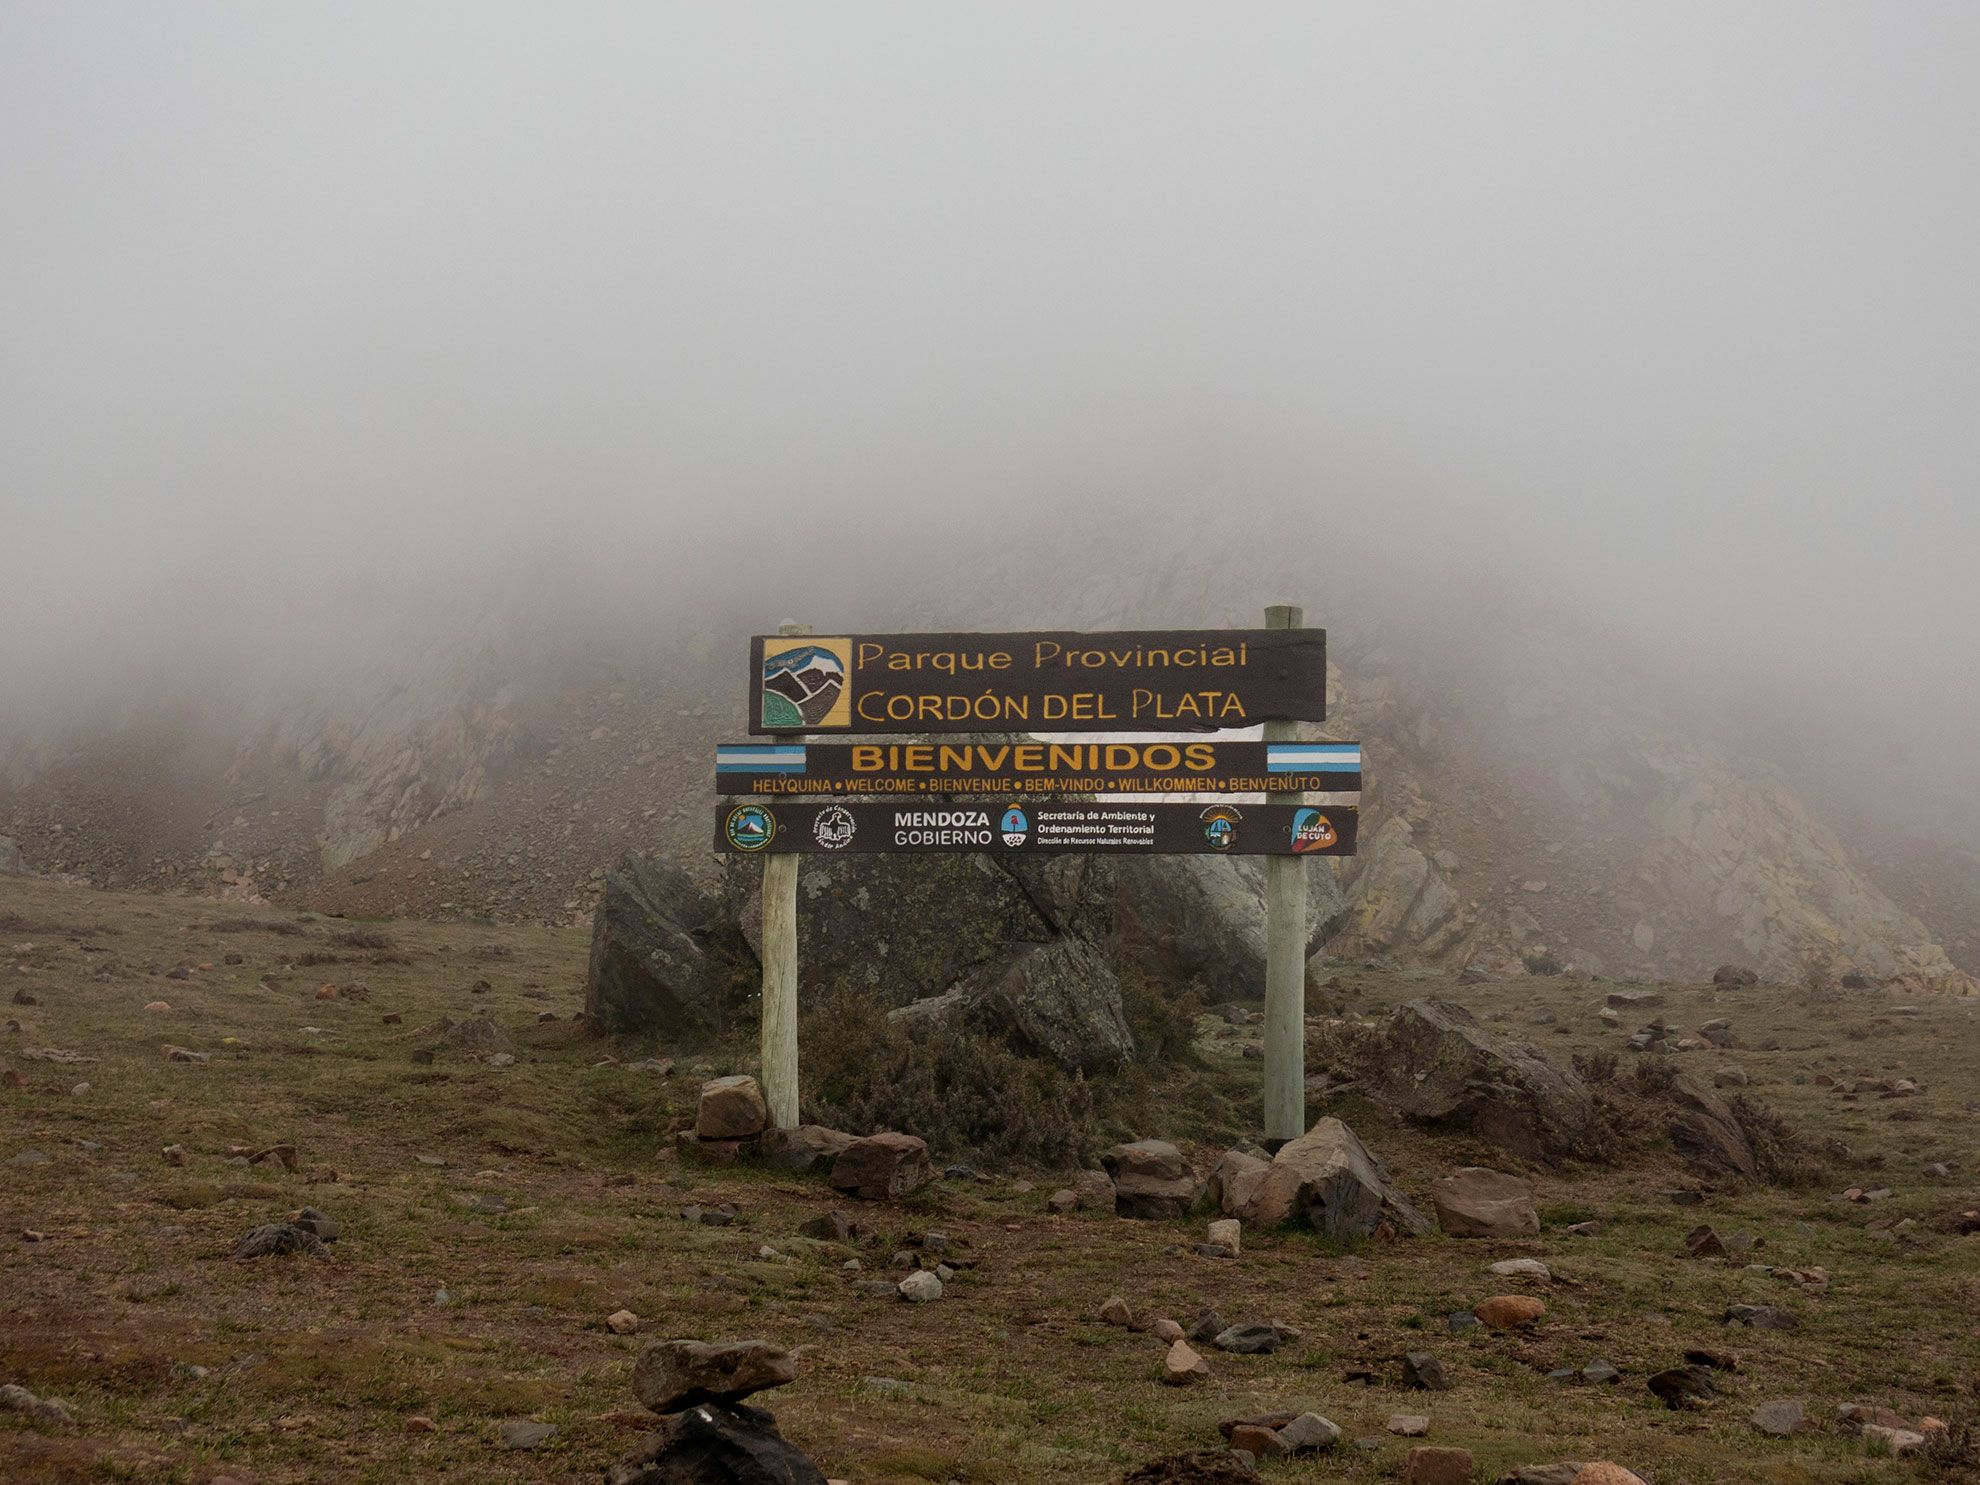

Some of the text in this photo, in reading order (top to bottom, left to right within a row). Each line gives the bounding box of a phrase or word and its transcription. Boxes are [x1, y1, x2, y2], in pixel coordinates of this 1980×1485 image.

[857, 641, 1247, 674] Parque Provincial
[857, 688, 1247, 722] CORDÓN DEL PLATA
[852, 744, 1216, 771] BIENVENIDOS
[845, 778, 915, 792] WELCOME
[929, 777, 1011, 792] BIENVENUE
[1025, 777, 1105, 791] BEM-VINDO
[1119, 777, 1217, 791] WILLKOMMEN
[1229, 776, 1321, 791] BENVENUTO
[894, 811, 990, 827] MENDOZA
[1037, 811, 1156, 822] Secretaría de Ambiente y
[1037, 824, 1155, 834] Ordenamiento Territorial
[1296, 832, 1332, 840] DE CUYO
[894, 830, 993, 845] GOBIERNO
[1070, 837, 1096, 845] Recursos
